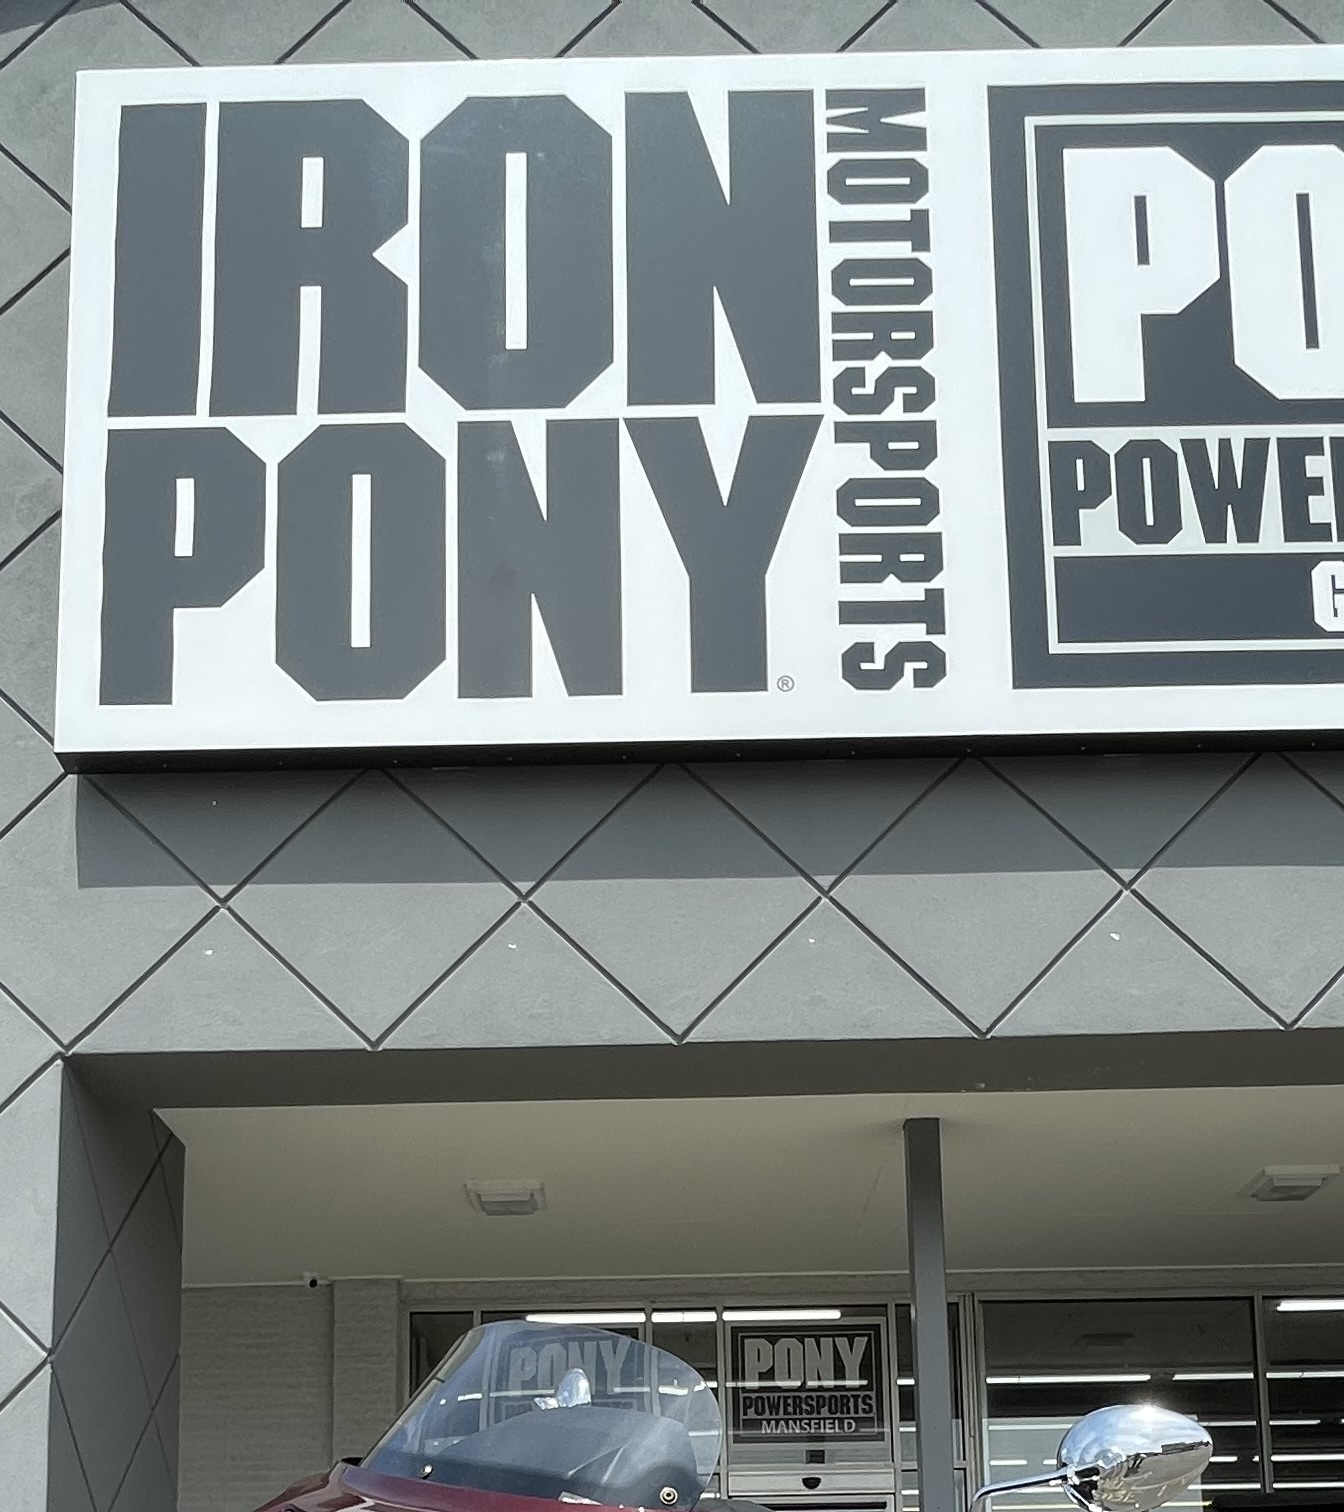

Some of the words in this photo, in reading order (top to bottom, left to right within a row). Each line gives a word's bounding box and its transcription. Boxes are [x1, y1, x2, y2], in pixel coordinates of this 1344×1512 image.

[107, 89, 822, 417] IRON
[825, 87, 948, 691] MOTORSPORTS
[99, 414, 825, 705] PONY
[742, 1394, 873, 1416] POWERSPORTS
[744, 1336, 868, 1389] PONY
[761, 1419, 856, 1434] MANSFIELD
